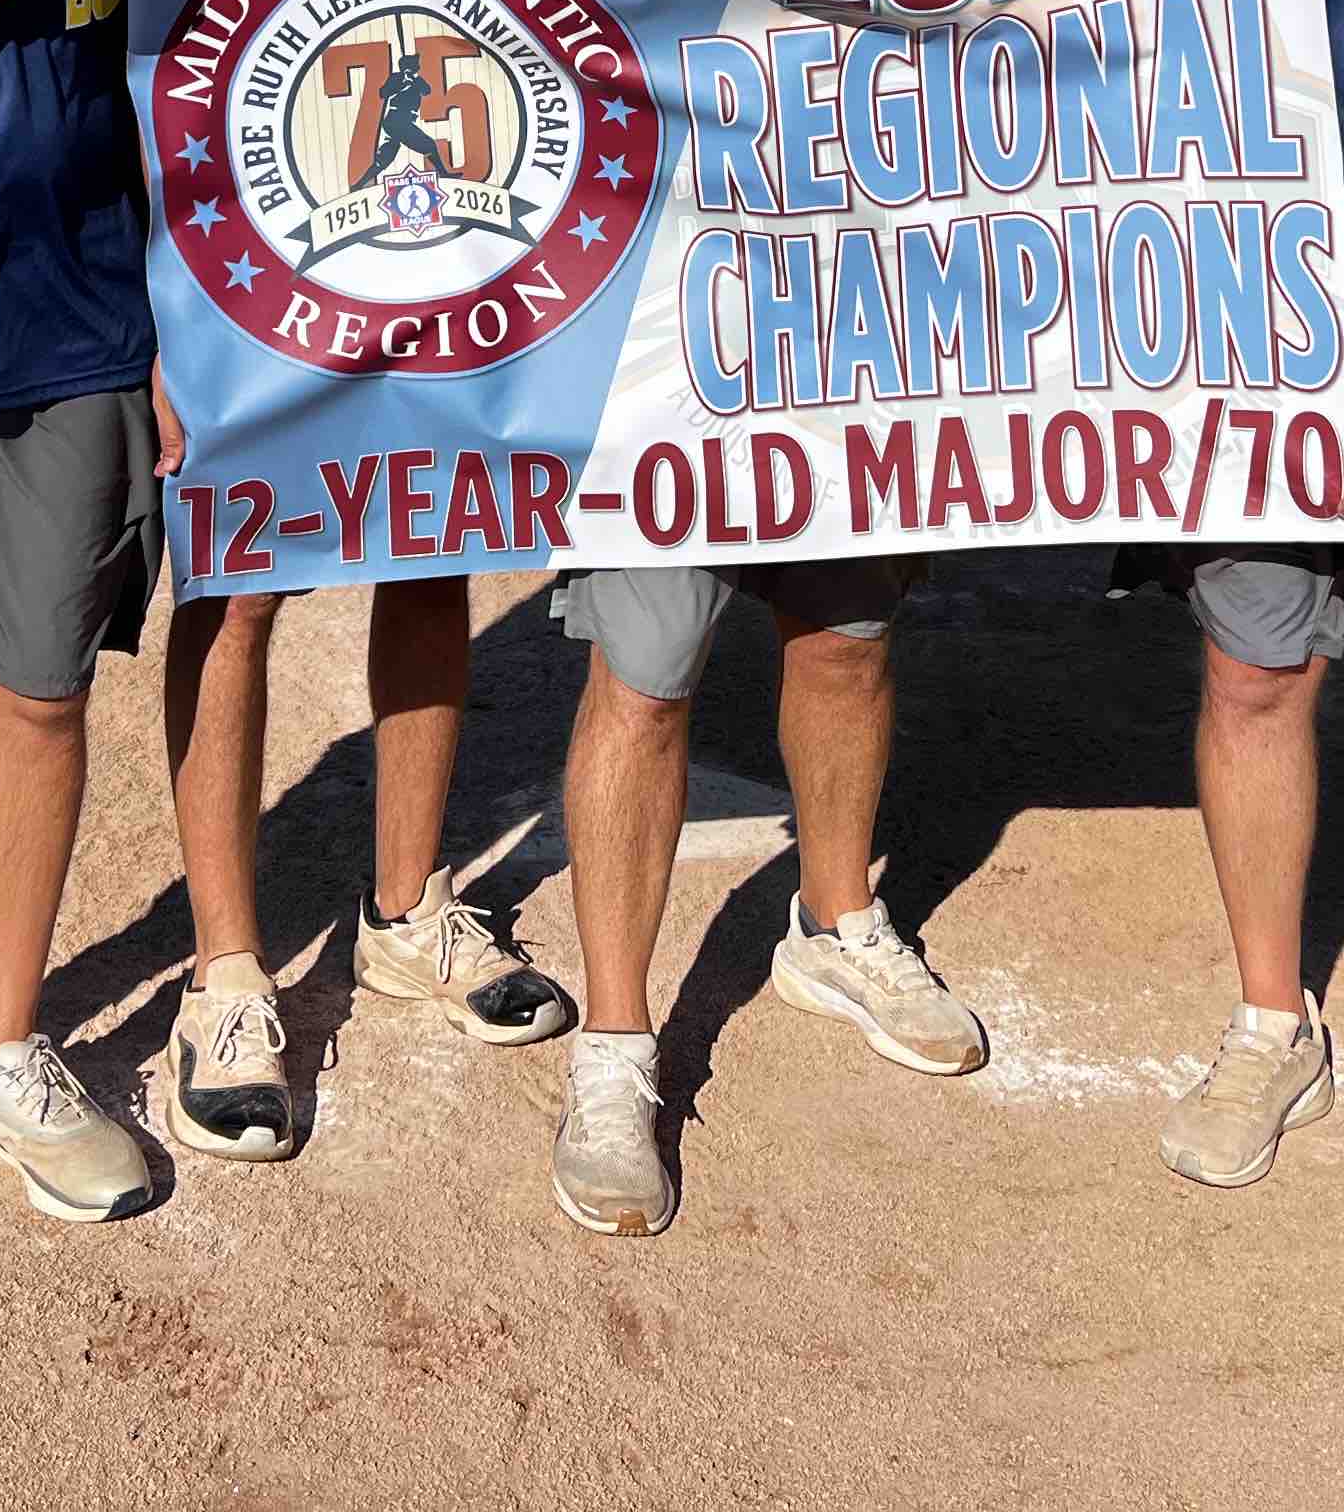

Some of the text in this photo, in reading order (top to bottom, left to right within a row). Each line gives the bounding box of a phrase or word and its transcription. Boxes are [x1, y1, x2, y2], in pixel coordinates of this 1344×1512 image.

[247, 18, 309, 111] RUTH
[322, 35, 495, 187] 75
[246, 123, 293, 216] BABE
[324, 197, 371, 234] 1951
[454, 187, 505, 216] 2026
[272, 260, 569, 360] REGION
[679, 200, 1343, 417] CHAMPIONS
[176, 431, 815, 579] 12-YEAR-OLD
[843, 398, 1344, 535] MAJOR/70
